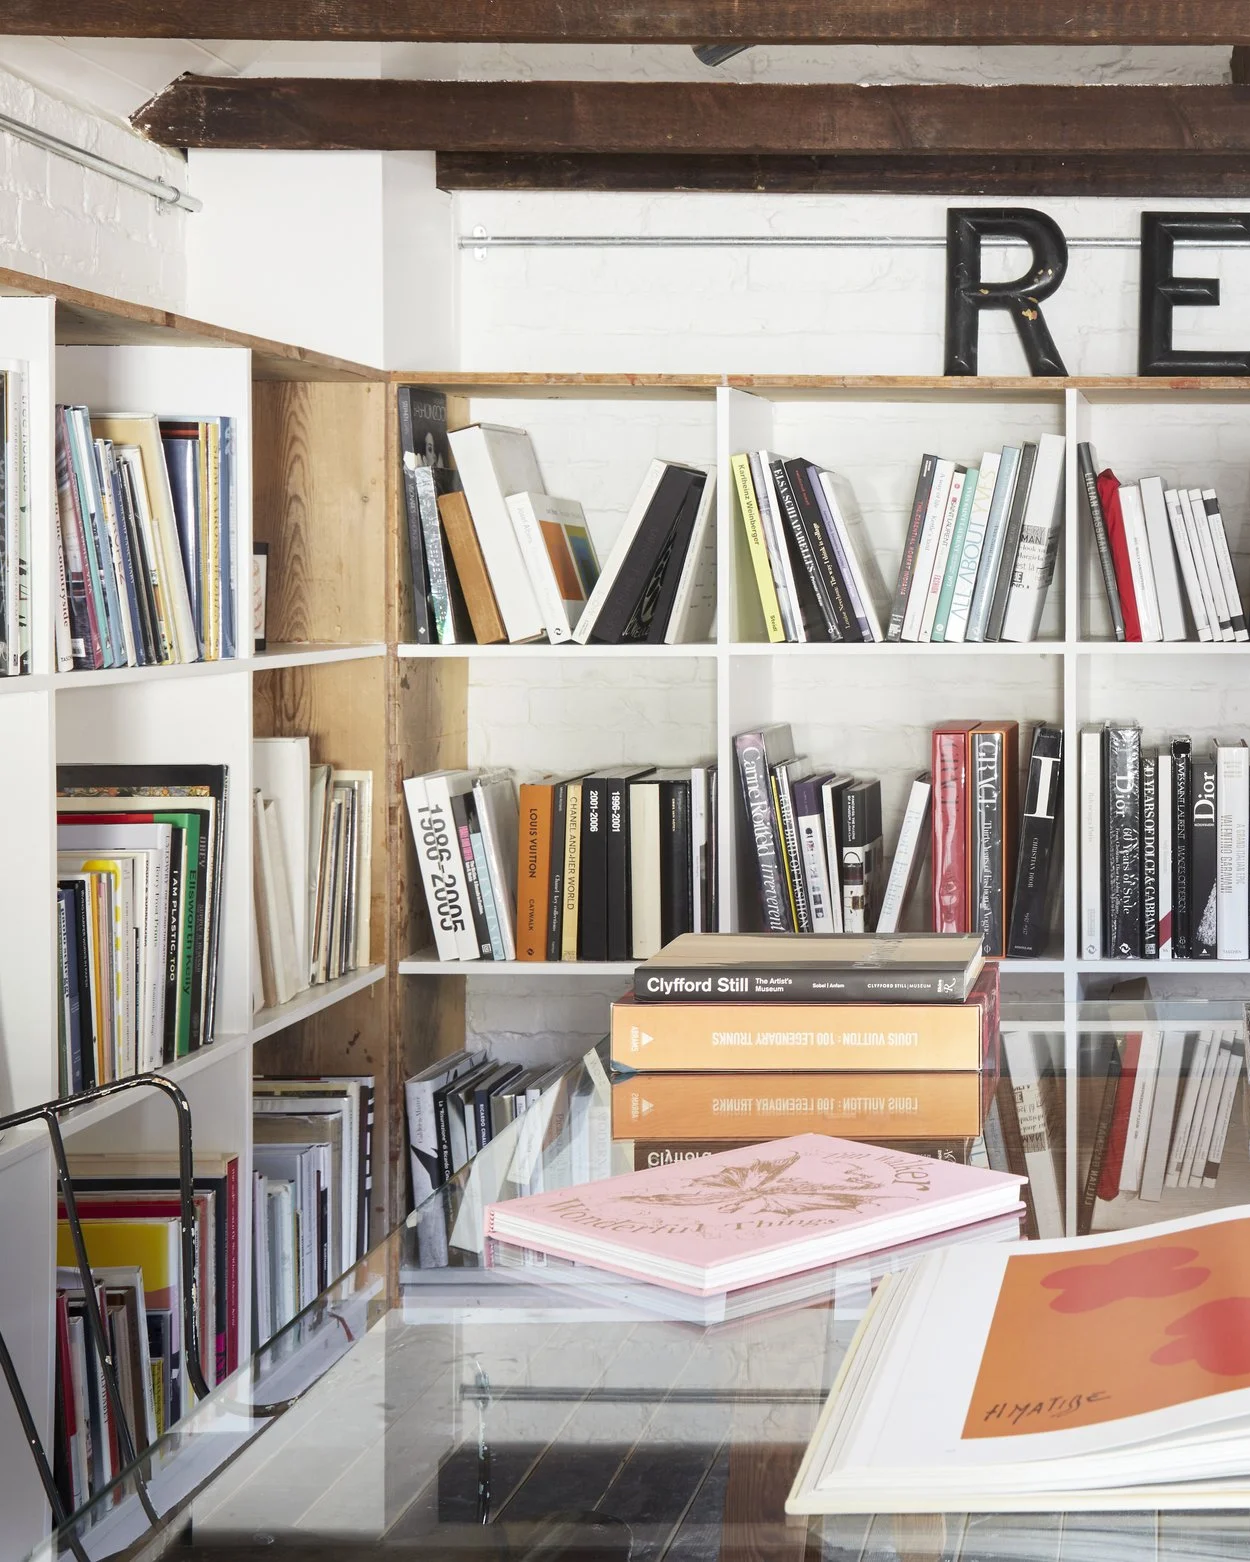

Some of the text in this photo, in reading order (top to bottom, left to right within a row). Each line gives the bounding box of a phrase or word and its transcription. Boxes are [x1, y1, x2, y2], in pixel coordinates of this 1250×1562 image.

[738, 464, 761, 546] Karlheinz Weinberger
[958, 522, 986, 589] ABOUT
[58, 551, 69, 628] Countryside
[950, 591, 971, 621] ALL
[769, 615, 778, 632] Steidl
[590, 790, 598, 832] 2001-2006
[611, 790, 620, 833] 1996-2001
[1194, 771, 1215, 823] Dior
[742, 746, 786, 931] Carine Roitfeld irreverent
[1114, 774, 1135, 915] Dior 60 Years of Style
[1220, 814, 1233, 894] VALENTINO GARAVANI
[153, 863, 161, 886] Terry
[417, 803, 466, 933] 1986-2005
[527, 808, 539, 932] LOUIS VUITTON CATWALK
[1027, 837, 1040, 888] CHRISTIAN DIOR
[171, 877, 177, 896] AM
[183, 869, 197, 996] Ellsworth Kelly
[646, 976, 793, 996] Clyfford Still The Artist's
[755, 985, 784, 993] Museum
[711, 1031, 919, 1047] LOUIS VUITTON 100 LEGENDARY TRUNKS
[439, 1107, 448, 1144] "Risurrezione"
[544, 1198, 843, 1235] Wonderful Things
